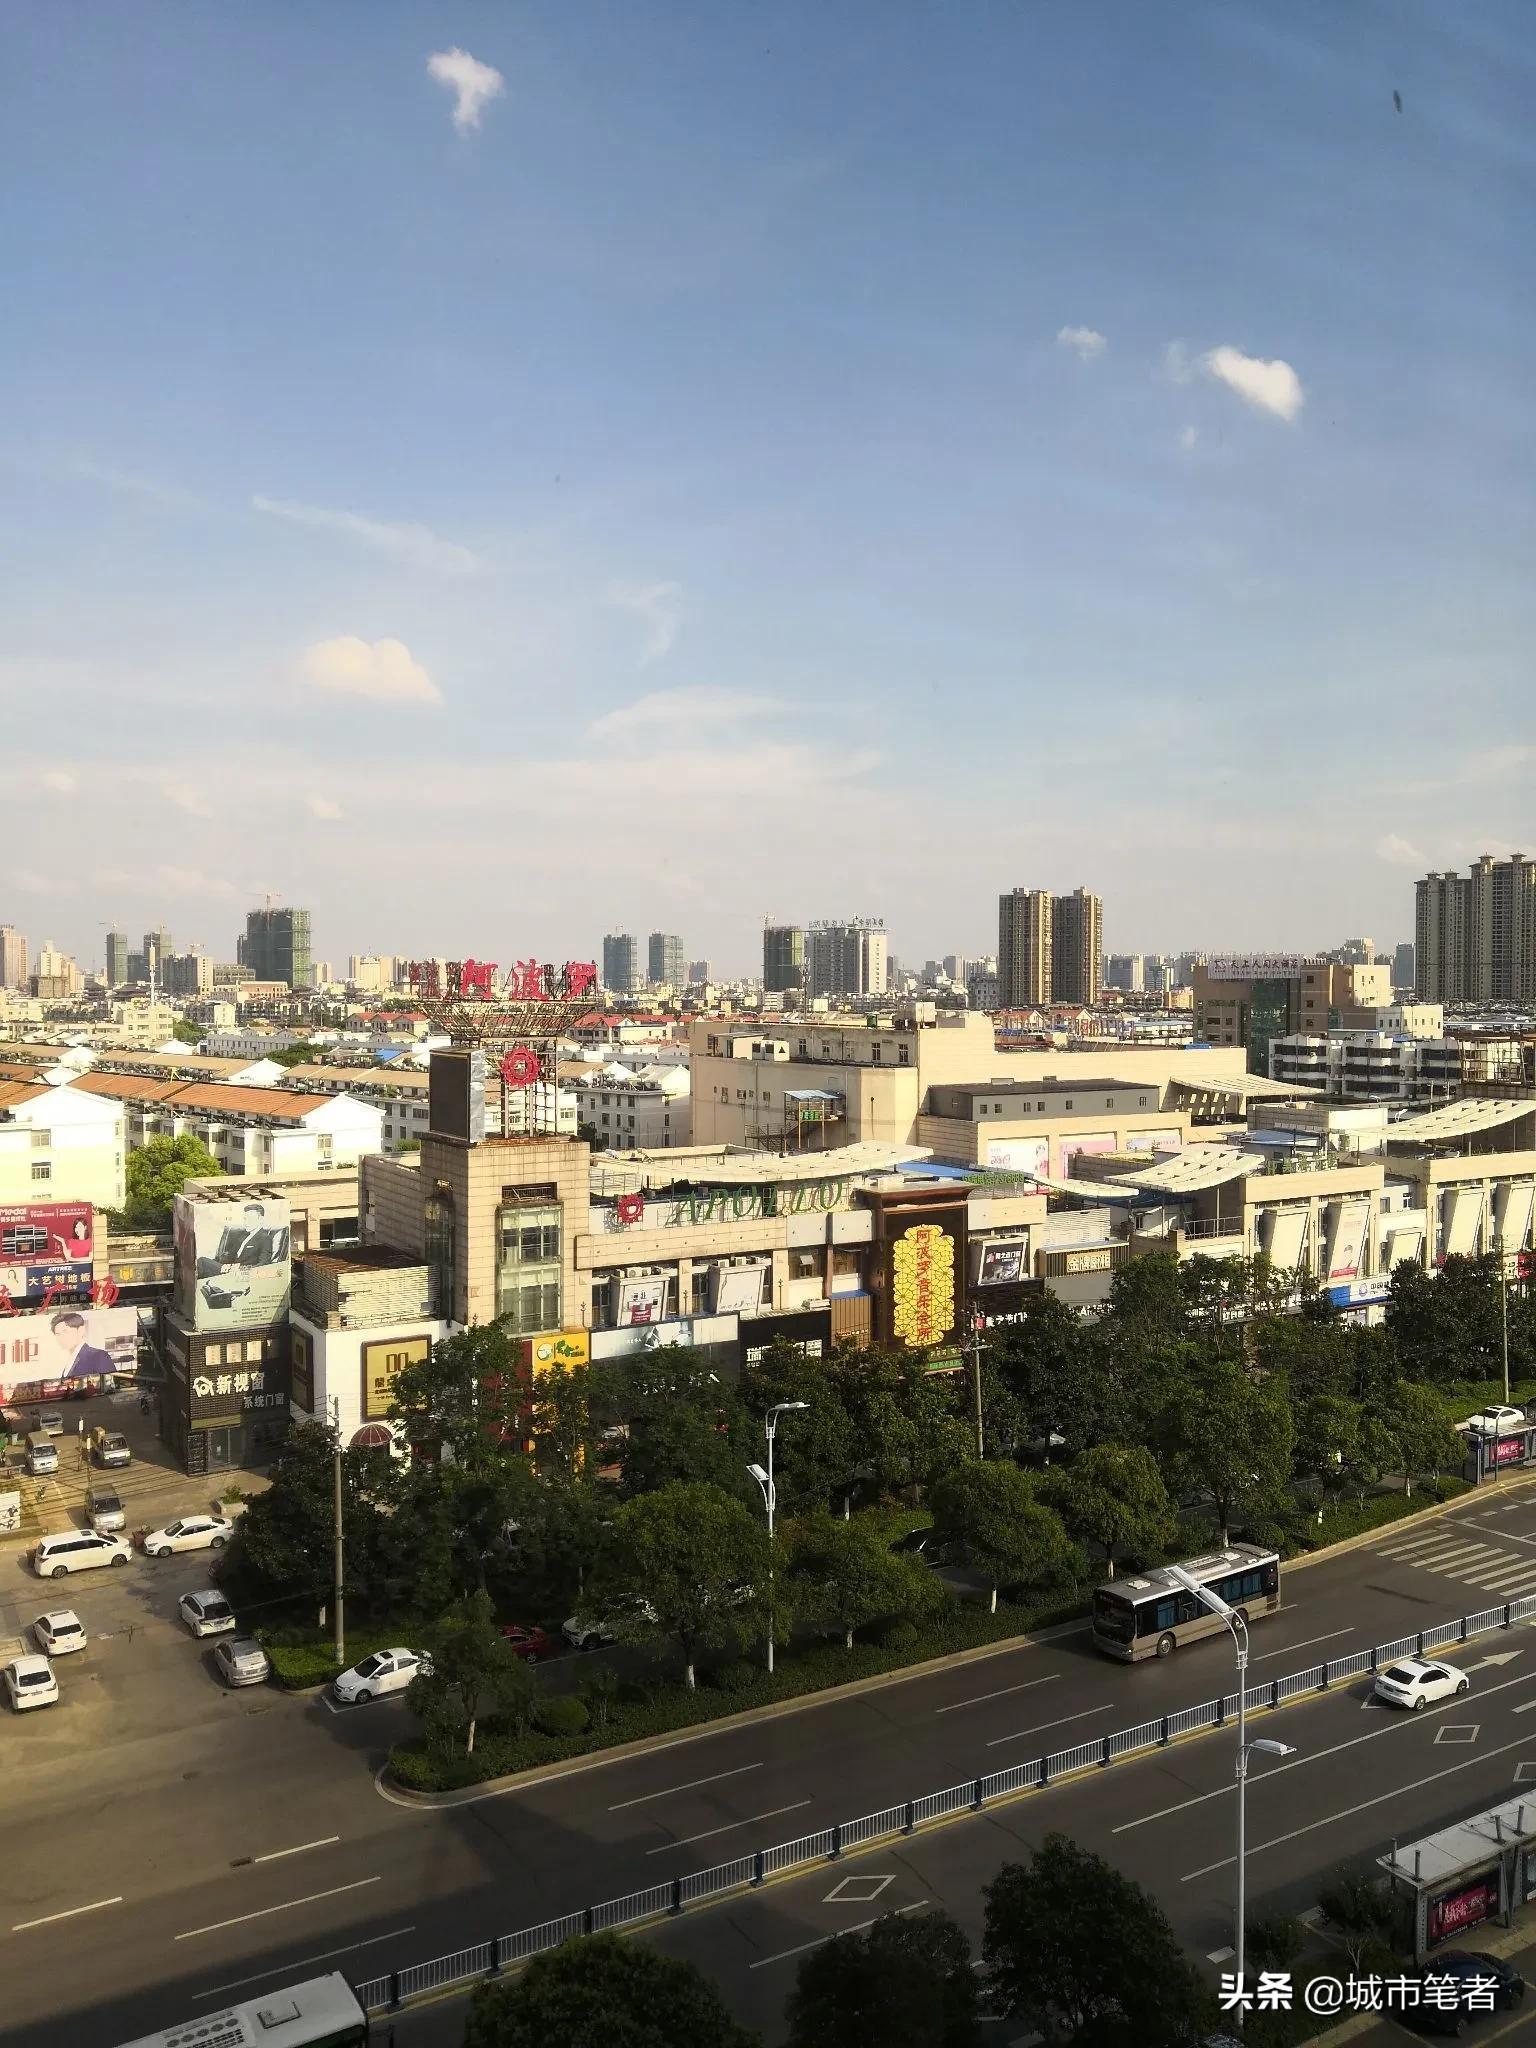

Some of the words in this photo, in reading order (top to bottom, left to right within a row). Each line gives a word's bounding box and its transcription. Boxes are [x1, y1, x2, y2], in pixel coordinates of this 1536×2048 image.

[460, 958, 597, 1002] 阿波罗
[664, 1176, 844, 1228] APOLLO
[28, 1272, 91, 1287] 大艺树地板
[916, 1229, 932, 1343] 阿波罗音乐会所
[216, 1372, 264, 1395] 新视窗
[243, 1393, 285, 1409] 系统门窗
